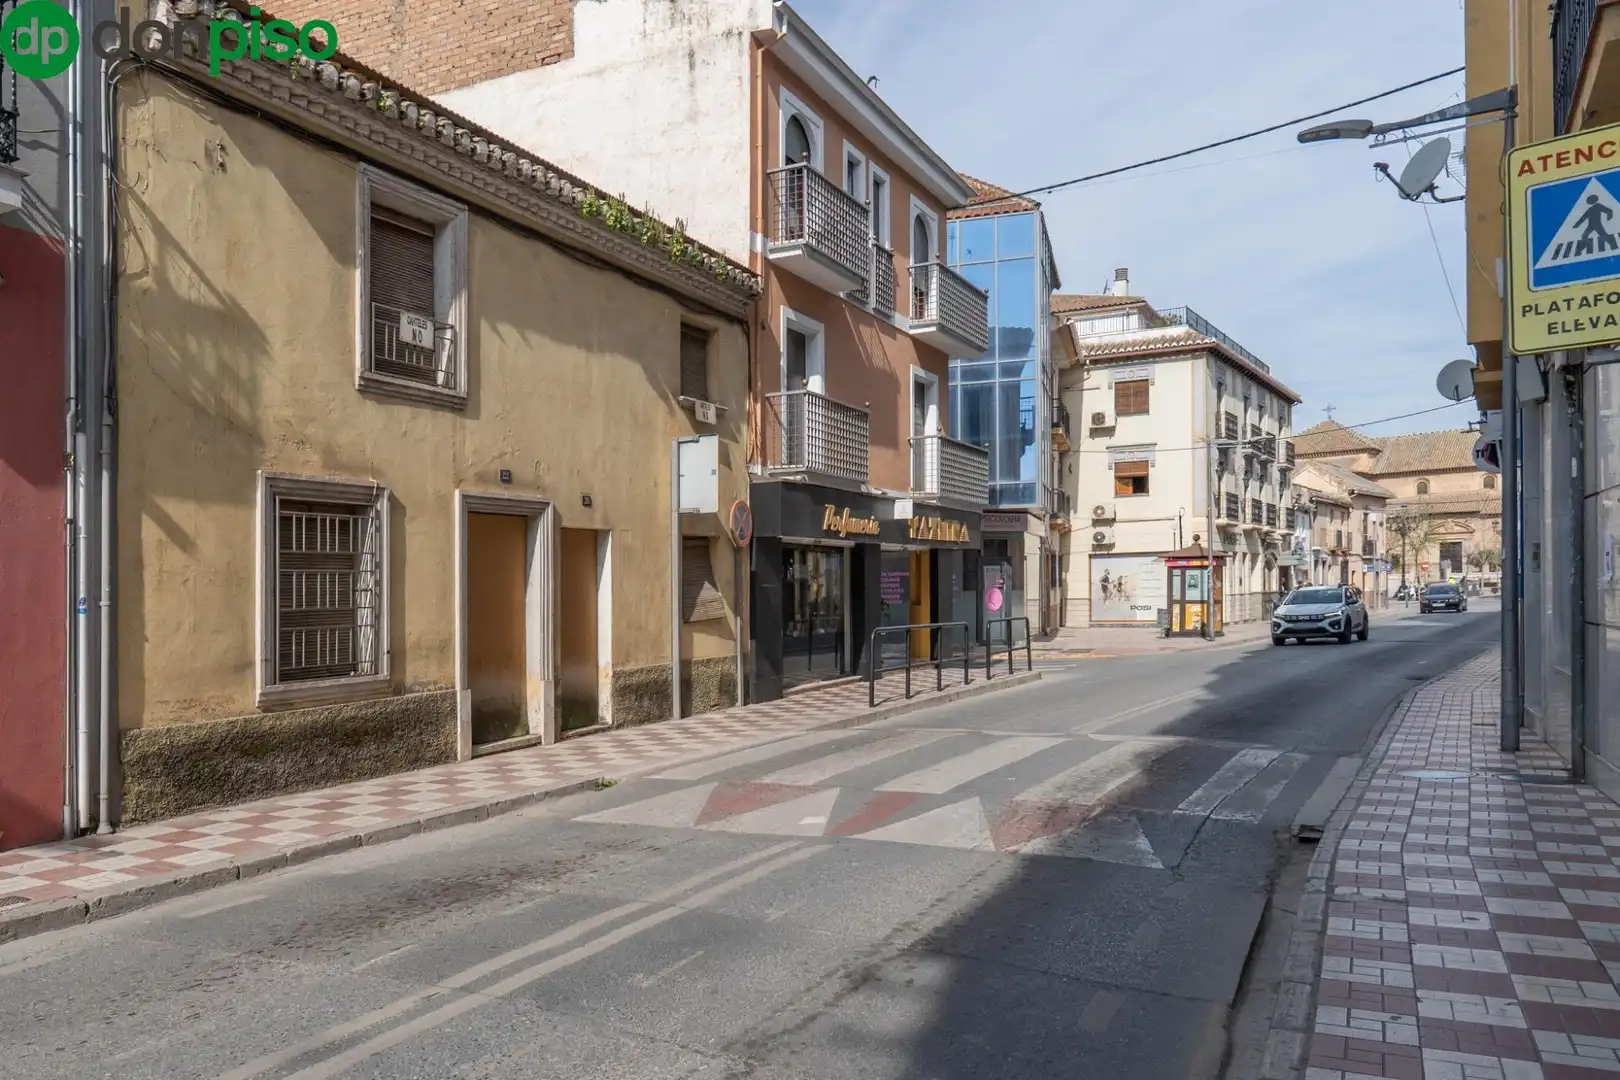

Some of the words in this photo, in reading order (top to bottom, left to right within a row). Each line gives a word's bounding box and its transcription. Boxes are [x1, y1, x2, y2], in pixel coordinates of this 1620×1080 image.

[1517, 140, 1620, 178] ATENC
[1521, 291, 1620, 318] PLATAFO
[412, 327, 423, 344] NO
[1547, 313, 1620, 336] ELEVA
